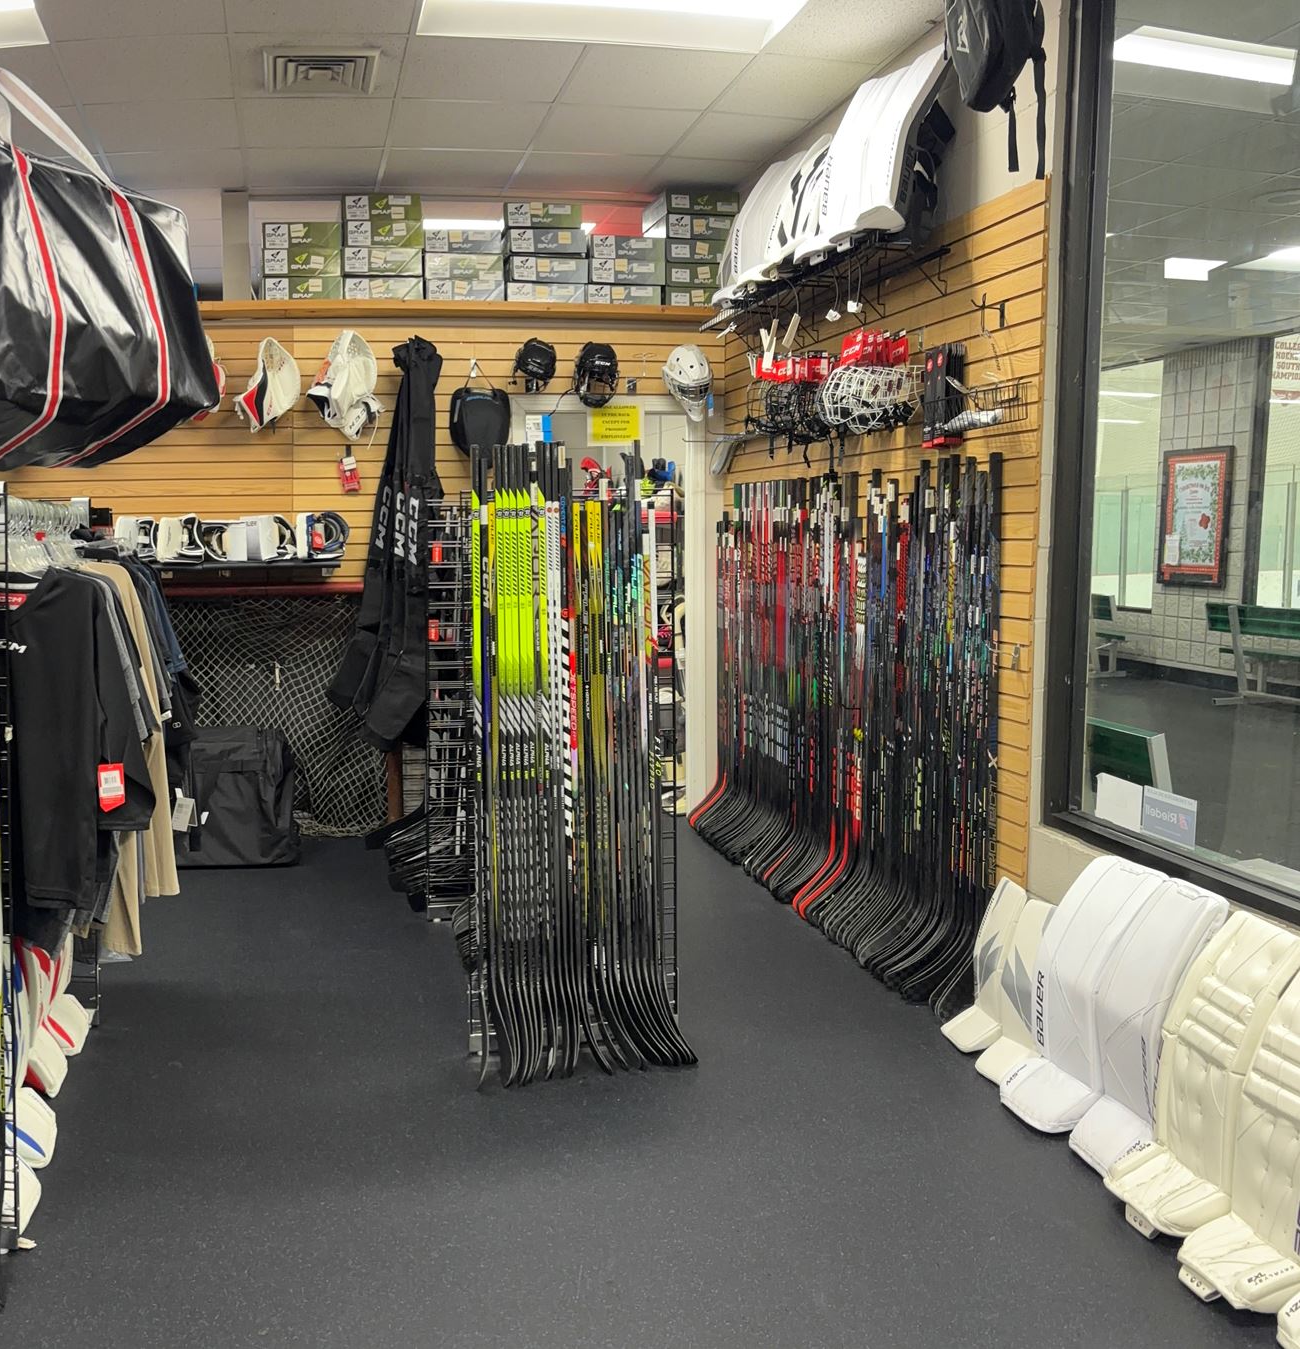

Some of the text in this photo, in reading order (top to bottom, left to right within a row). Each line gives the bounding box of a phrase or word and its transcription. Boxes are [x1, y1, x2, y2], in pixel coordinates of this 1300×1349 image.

[820, 155, 834, 216] BAUER
[902, 144, 914, 204] BAUER
[842, 344, 860, 358] CCM
[1276, 352, 1299, 360] HOCK
[376, 485, 392, 550] CCM
[394, 492, 406, 558] CCM
[408, 496, 420, 566] CCM
[482, 556, 490, 608] CCM
[530, 505, 540, 597] VAPOR
[986, 748, 998, 888] PROJECT X
[1036, 970, 1044, 1048] BAUER
